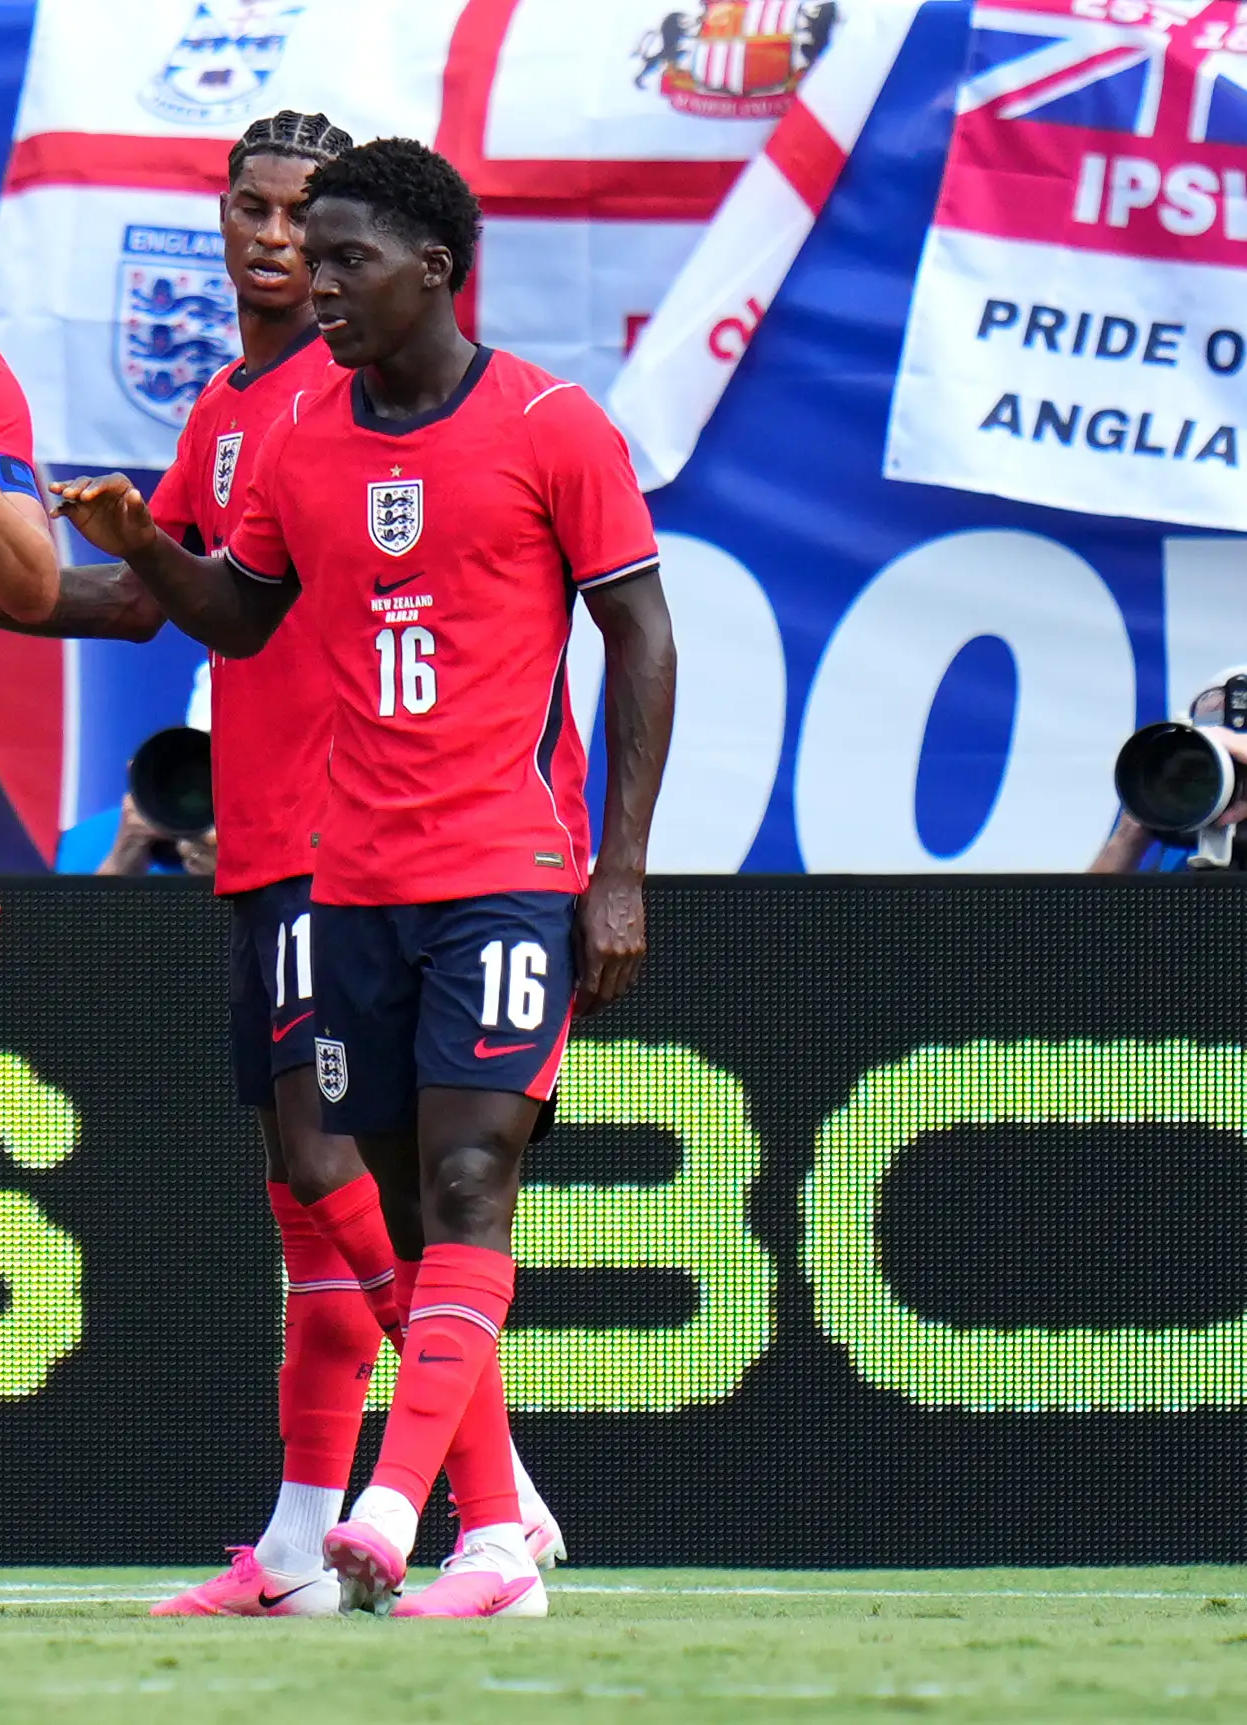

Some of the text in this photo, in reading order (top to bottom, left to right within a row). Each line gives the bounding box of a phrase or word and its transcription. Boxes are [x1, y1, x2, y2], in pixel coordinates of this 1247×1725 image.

[976, 299, 1186, 367] PRIDE
[977, 393, 1239, 467] ANGLIA
[371, 595, 433, 611] NEW ZEALAND
[376, 626, 437, 717] 16
[276, 913, 313, 1008] 11
[480, 940, 547, 1030] 16
